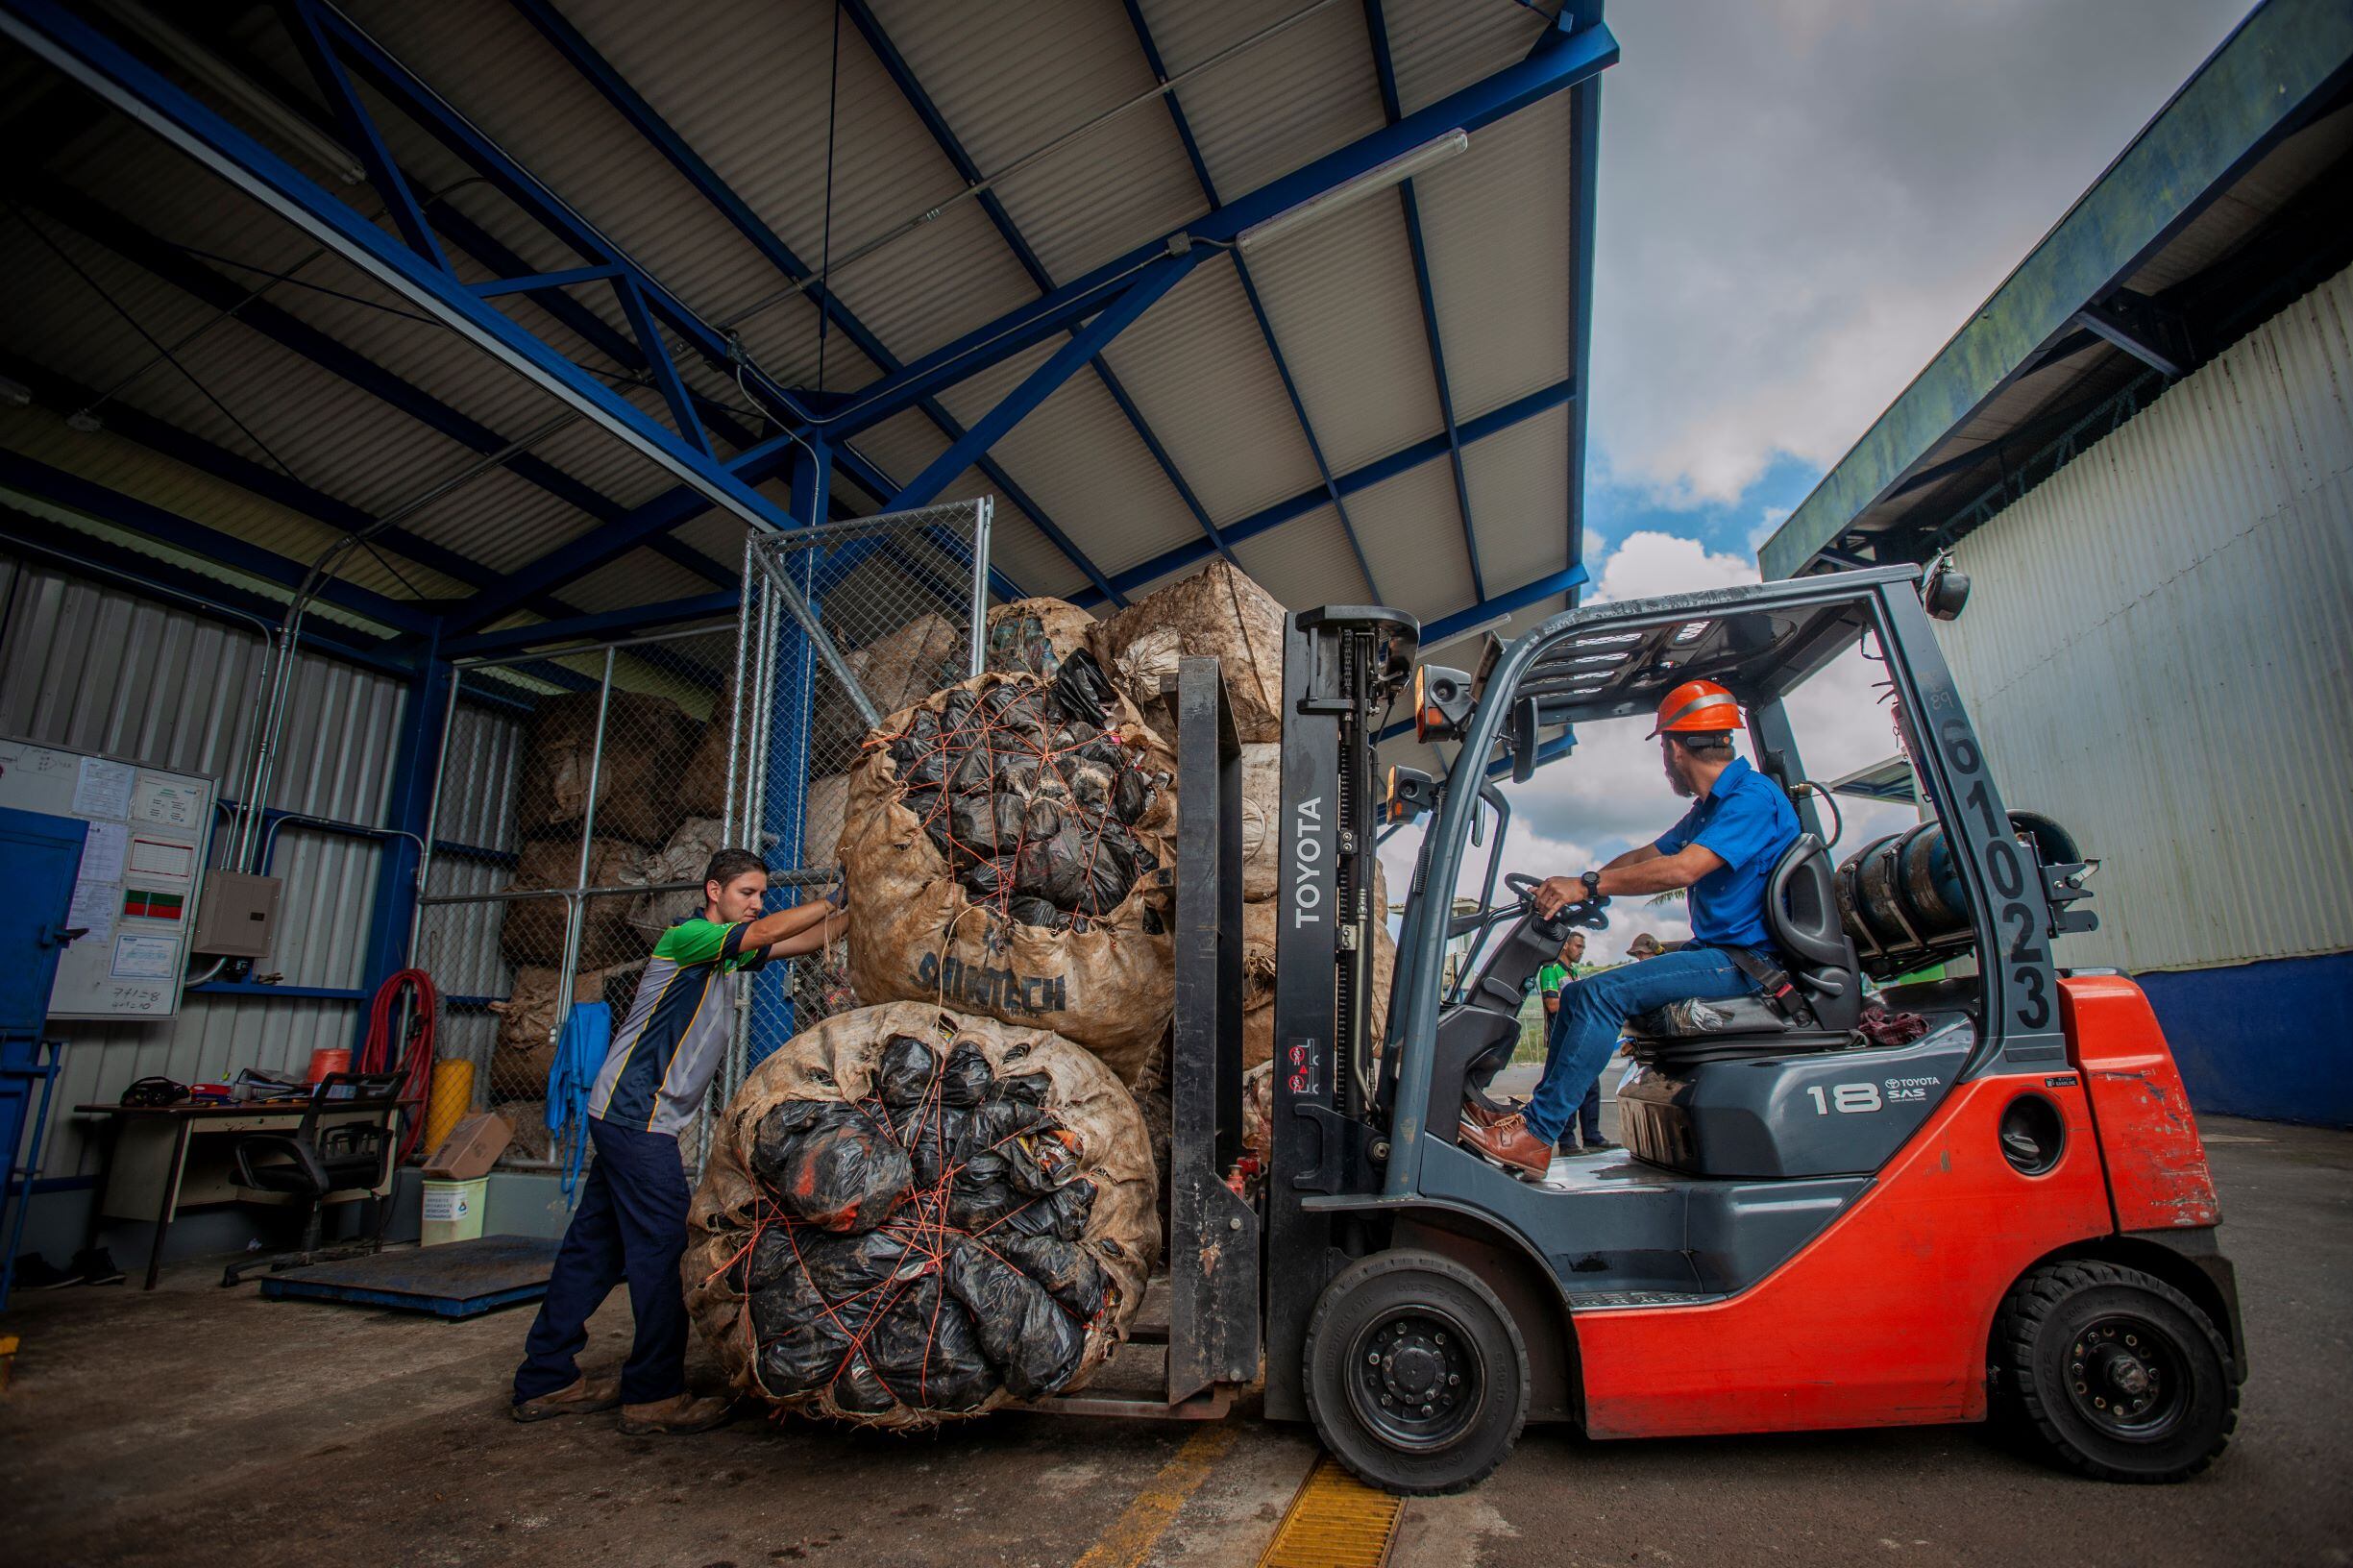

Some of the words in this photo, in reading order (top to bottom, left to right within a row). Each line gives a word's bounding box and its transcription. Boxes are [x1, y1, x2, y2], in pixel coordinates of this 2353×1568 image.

[1295, 796, 1321, 929] TOYOTA
[1941, 719, 2050, 1030] 61023
[1887, 1088, 1925, 1099] SAS
[1900, 1076, 1941, 1087] TOYOTA
[1807, 1083, 1882, 1115] 18
